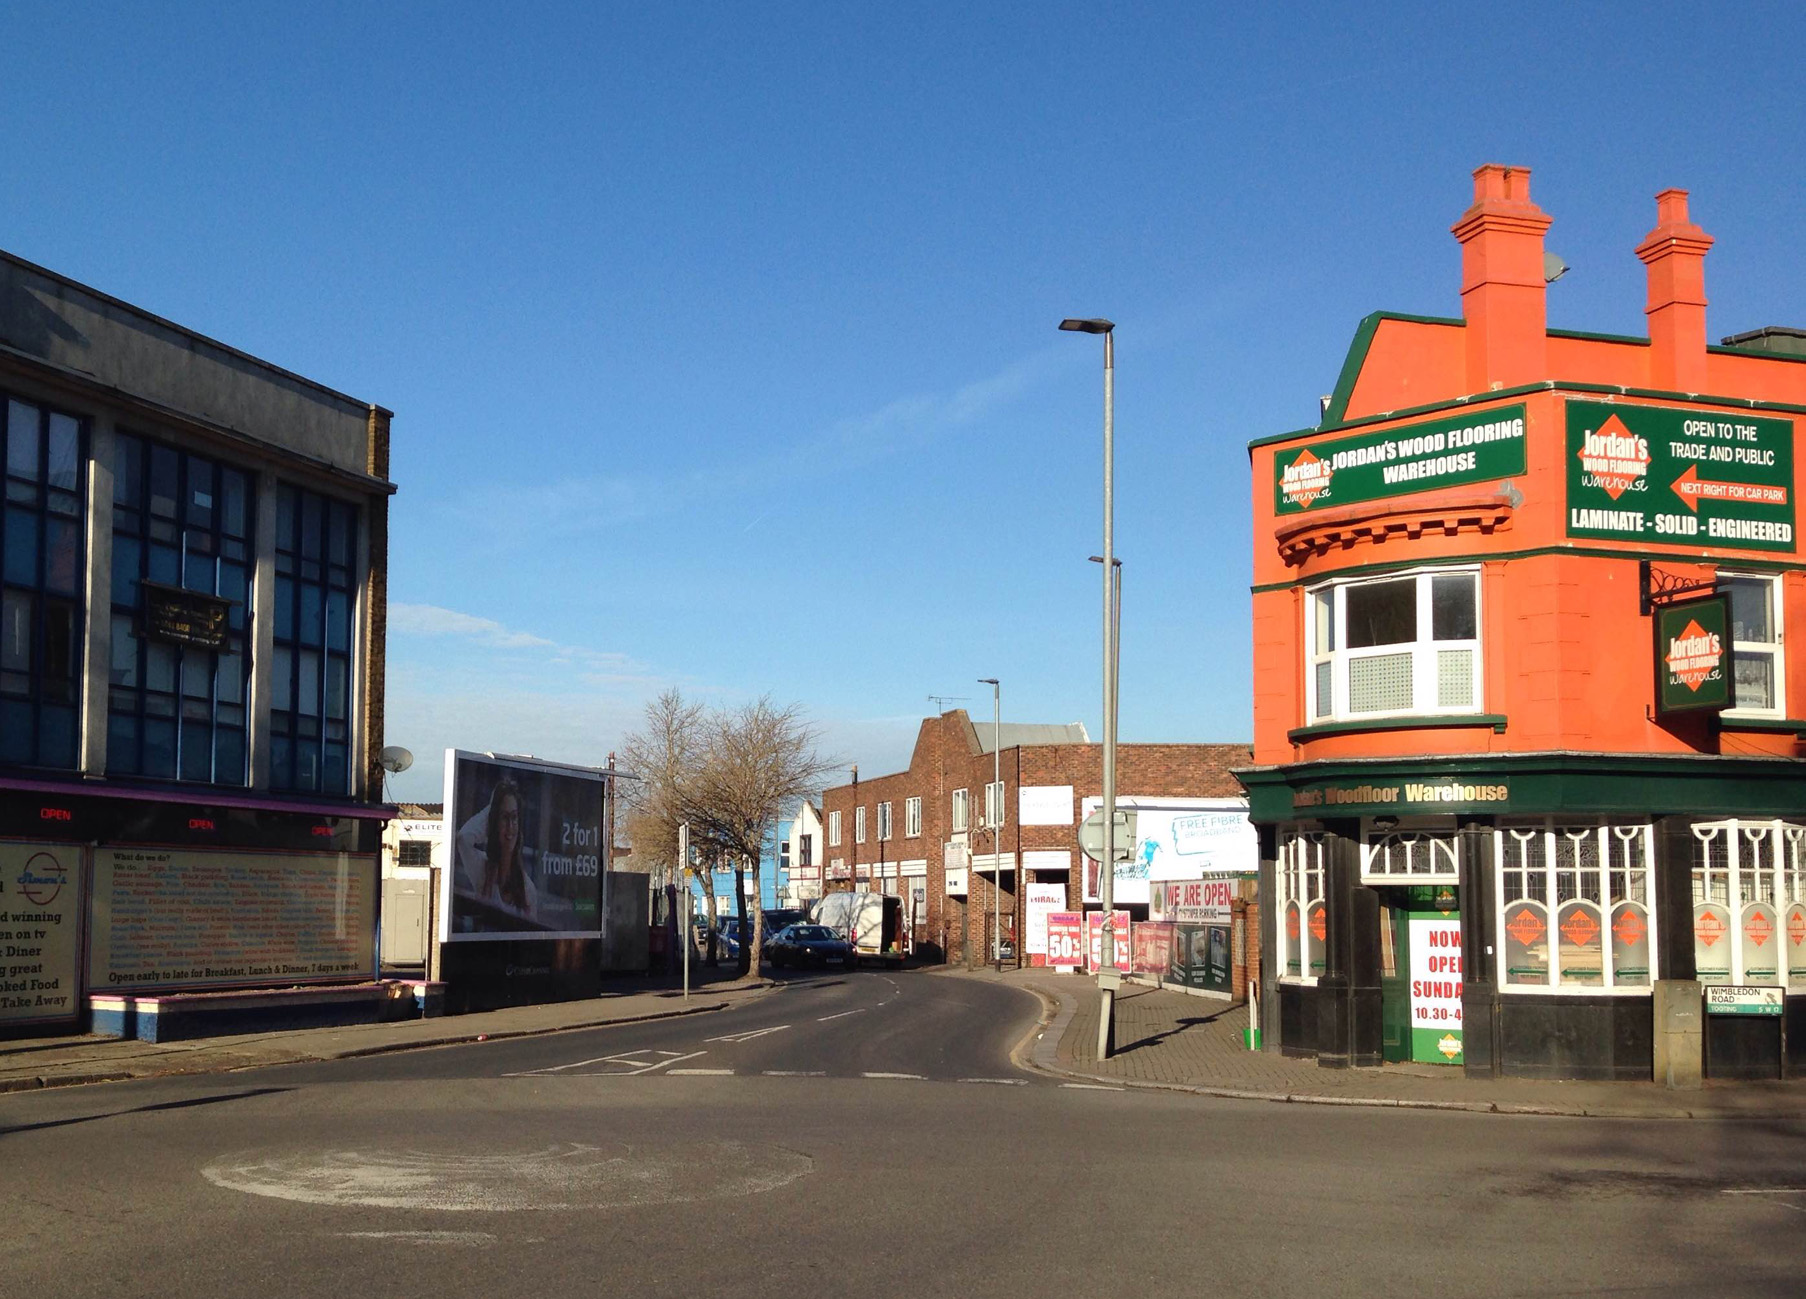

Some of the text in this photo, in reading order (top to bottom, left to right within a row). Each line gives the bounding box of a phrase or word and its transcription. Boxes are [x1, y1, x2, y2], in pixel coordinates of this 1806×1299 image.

[1683, 420, 1757, 441] OPEN TO THE
[1331, 418, 1523, 471] JORDAN'S WOOD FLOORING
[1584, 429, 1648, 460] Jordan's
[1669, 442, 1775, 466] TRADE AND PUBLIC
[1283, 458, 1331, 483] Jordan's
[1383, 452, 1476, 484] WAREHOUSE
[1583, 458, 1647, 475] WOOD FLOORING
[1301, 476, 1330, 491] FLOORING
[1681, 482, 1784, 501] NEXT RIGHT FOR CAR PARK
[1571, 508, 1644, 531] LAMINATE
[1655, 514, 1697, 535] SOLID
[1708, 517, 1792, 543] ENGINEERED
[1669, 632, 1720, 659] Jordan's
[1669, 655, 1719, 673] WOOD FLOORING
[1325, 785, 1399, 804] Woodfloor
[1405, 782, 1508, 802] Warehouse
[40, 808, 71, 821] OPEN
[1180, 814, 1243, 830] FREE FIBRE
[189, 819, 215, 829] OPEN
[562, 823, 598, 847] 2 for 1
[113, 853, 133, 861] What
[135, 853, 144, 861] do
[157, 854, 170, 862] do?
[543, 852, 598, 877] from £69
[1167, 882, 1232, 906] WE ARE OPEN
[11, 913, 62, 925] winning
[16, 931, 31, 939] on
[34, 930, 47, 939] tv
[1429, 930, 1463, 947] NOW
[6, 946, 42, 957] Diner
[9, 963, 43, 977] great
[109, 972, 135, 984] Open
[137, 971, 160, 981] early
[163, 971, 171, 979] to
[173, 969, 189, 979] late
[191, 968, 203, 978] for
[205, 967, 246, 977] Breakfast,
[249, 967, 272, 975] Lunch
[274, 966, 281, 974] &
[282, 965, 310, 975] Dinner,
[318, 963, 334, 973] days
[30, 978, 59, 990] Food
[1413, 980, 1463, 999] SUNDA
[1710, 988, 1760, 996] WIMBLEDON
[1, 995, 68, 1009] Take Away
[1711, 995, 1735, 1003] ROAD
[1415, 1007, 1463, 1021] 10.30-4
